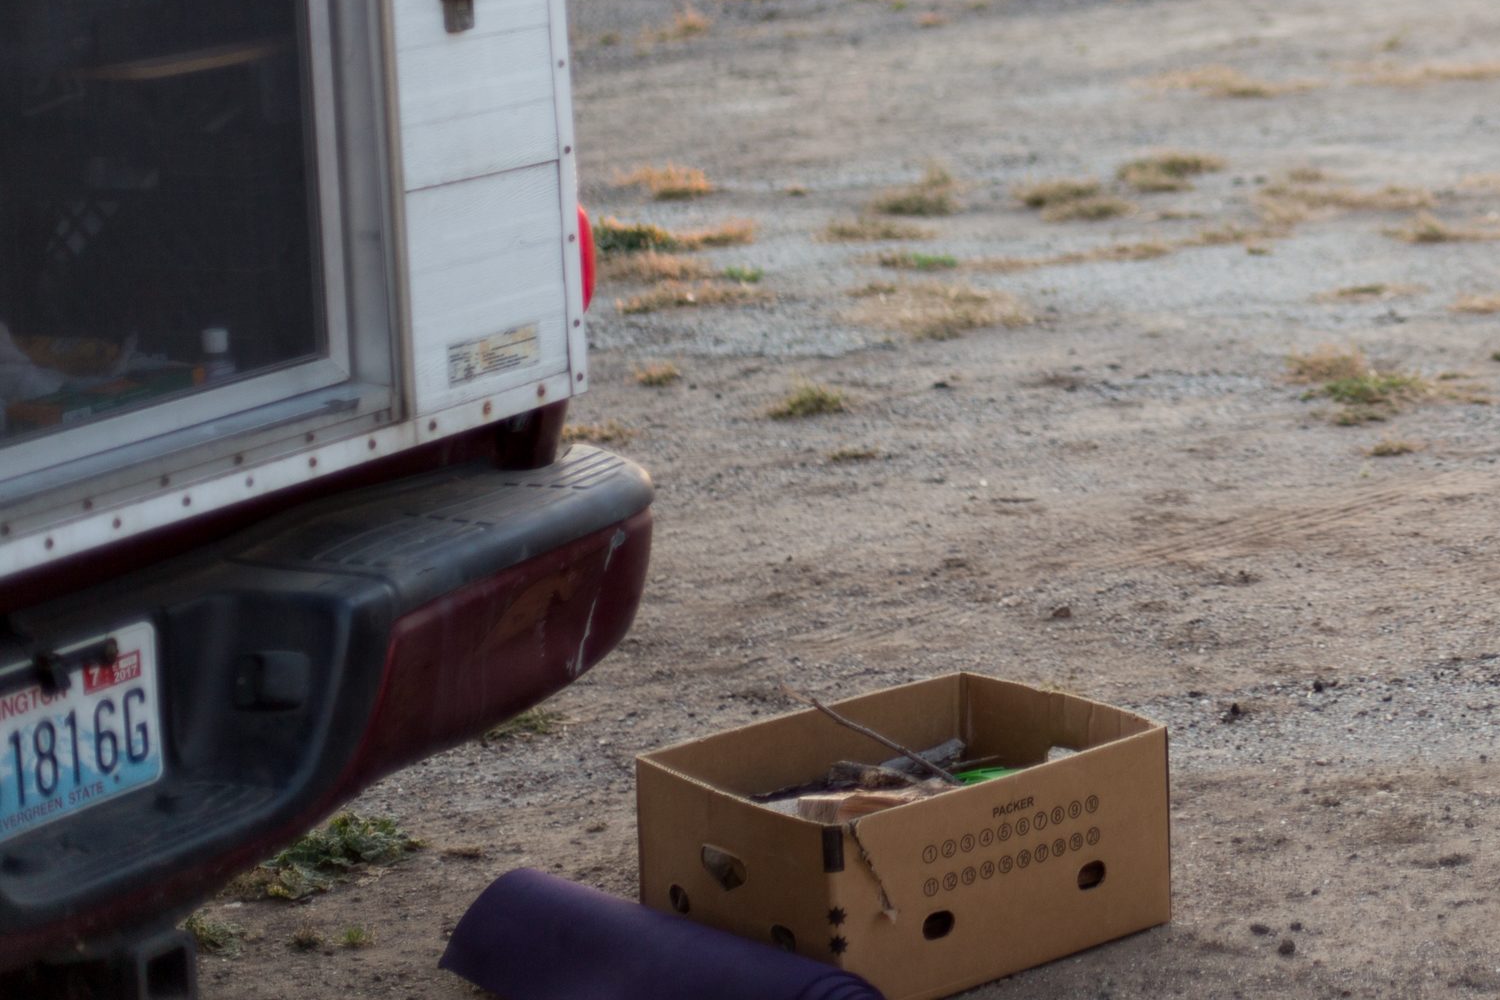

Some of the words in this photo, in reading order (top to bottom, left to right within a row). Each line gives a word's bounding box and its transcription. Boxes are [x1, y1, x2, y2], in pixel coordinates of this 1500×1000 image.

[89, 667, 100, 686] 7
[113, 664, 137, 682] 2017
[0, 796, 64, 830] VERGREEN
[68, 781, 104, 805] STATE
[992, 797, 1034, 817] PACKER
